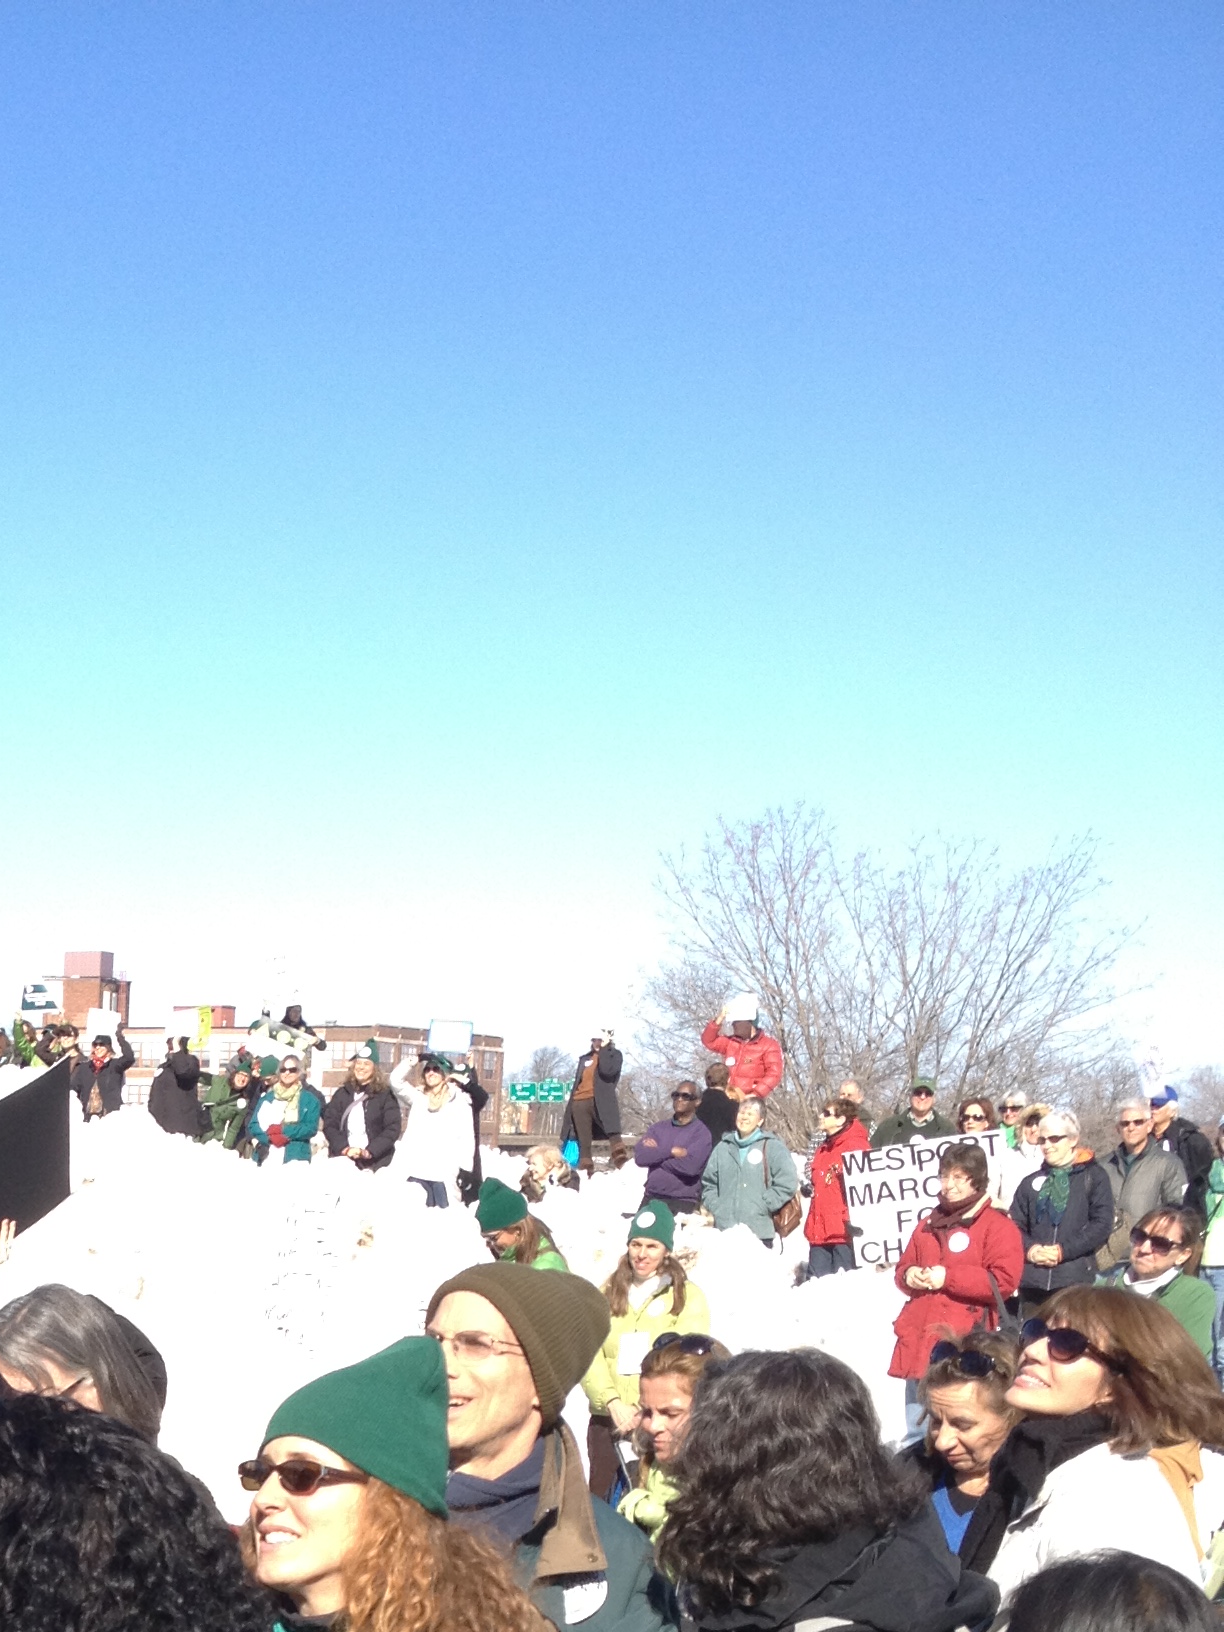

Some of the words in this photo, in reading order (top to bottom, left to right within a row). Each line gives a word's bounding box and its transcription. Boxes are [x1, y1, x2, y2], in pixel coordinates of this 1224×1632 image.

[848, 1175, 943, 1207] MARC
[896, 1207, 934, 1232] FO
[861, 1238, 904, 1264] CH
